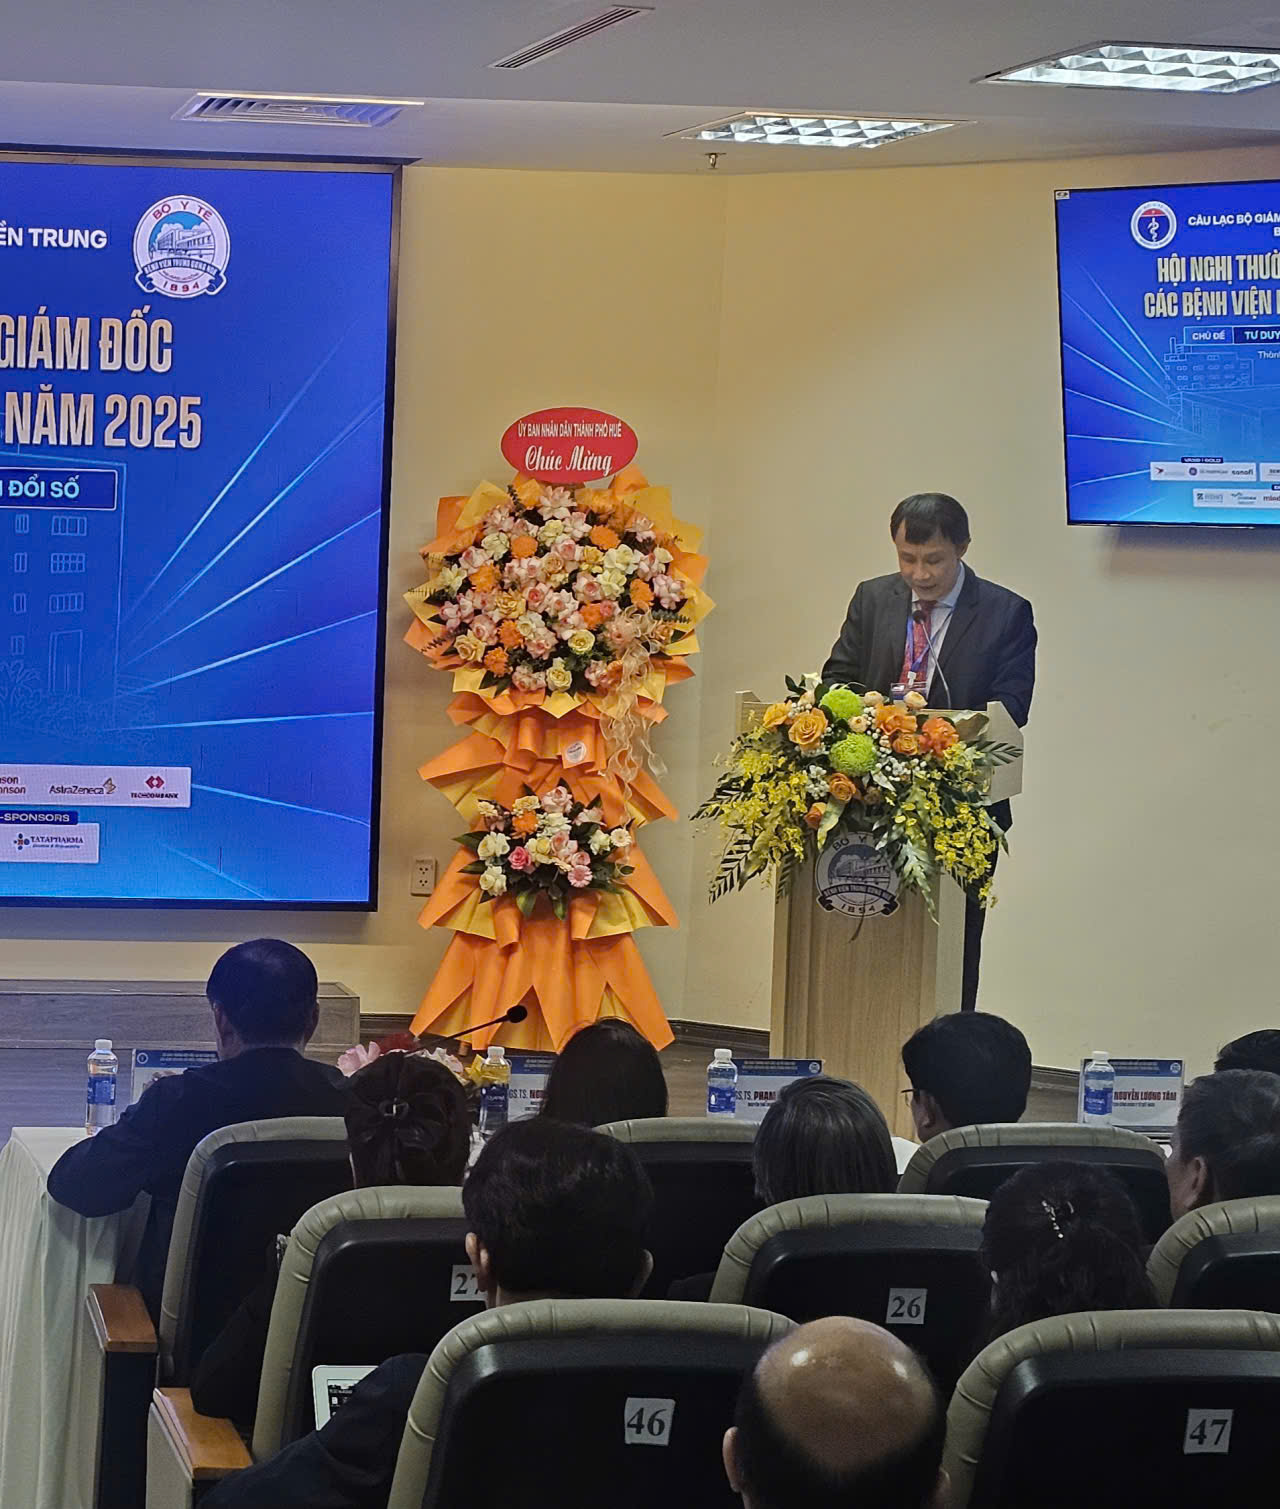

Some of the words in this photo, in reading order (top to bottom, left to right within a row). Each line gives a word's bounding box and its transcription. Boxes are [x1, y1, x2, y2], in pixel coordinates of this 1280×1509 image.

[180, 201, 189, 210] Y
[1188, 214, 1211, 226] CÂU
[1213, 215, 1235, 227] LẠC
[1236, 212, 1253, 227] BỘ
[28, 227, 108, 249] TRUNG
[1157, 253, 1186, 286] HỘI
[1190, 255, 1233, 285] NGHỊ
[163, 280, 200, 292] 1894
[1143, 288, 1178, 318] CÁC
[1182, 287, 1228, 320] BỆNH
[1231, 285, 1272, 320] VIỆN
[99, 305, 174, 373] ĐỐC
[1244, 330, 1258, 340] TƯ
[4, 383, 94, 446] NĂM
[104, 394, 202, 449] 2025
[527, 423, 540, 437] BAN
[525, 445, 563, 471] Chúc
[565, 445, 613, 476] Mừng
[8, 474, 45, 498] ĐỔI
[49, 474, 80, 499] SỐ
[49, 785, 104, 795] AstraZeneca
[890, 1295, 922, 1318] 26
[627, 1407, 667, 1437] 46
[1190, 1419, 1228, 1446] 47
